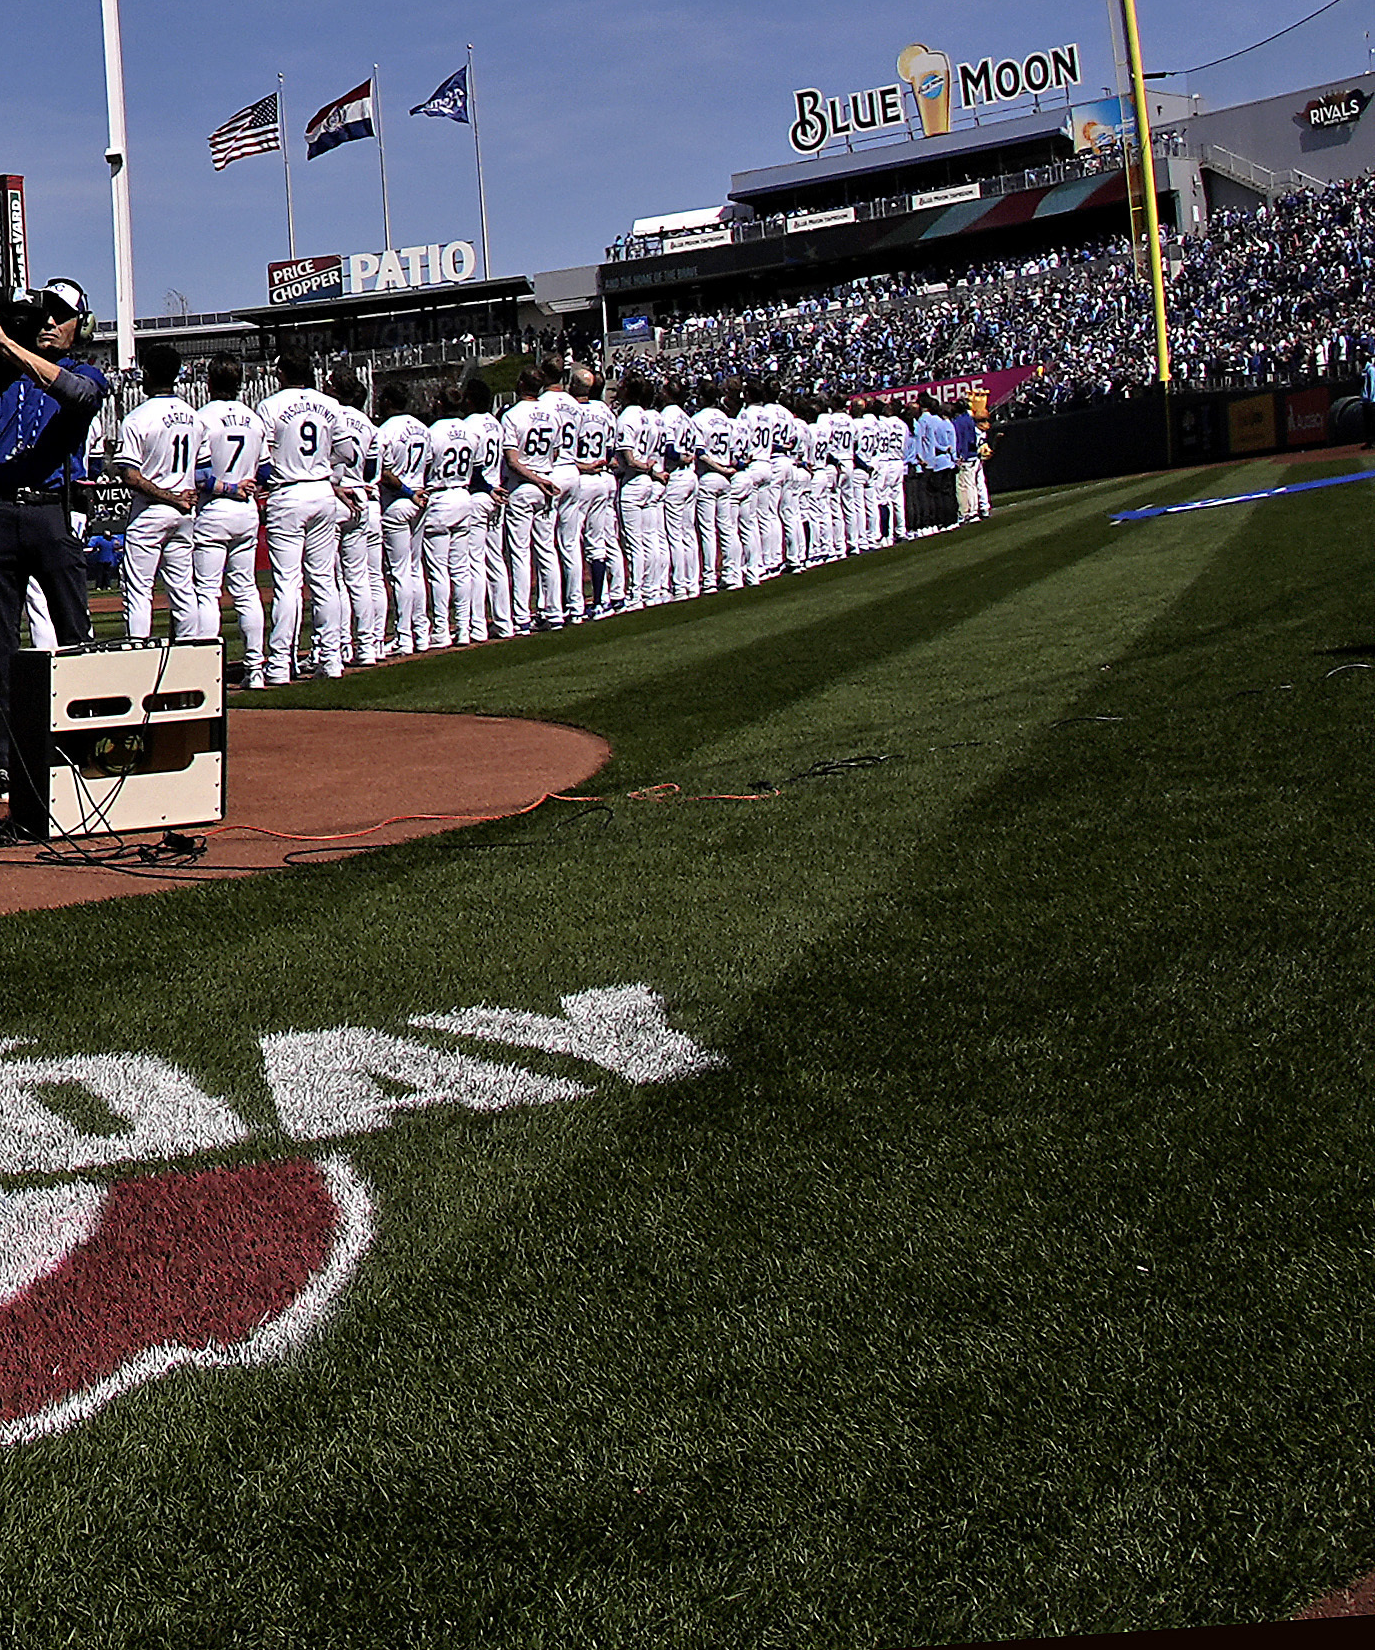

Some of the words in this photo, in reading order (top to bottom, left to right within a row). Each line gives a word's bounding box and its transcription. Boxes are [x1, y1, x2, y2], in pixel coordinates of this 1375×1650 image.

[788, 83, 904, 154] BLUE
[957, 43, 1082, 110] MOON
[1310, 99, 1360, 125] RIVALS
[272, 259, 316, 285] PRICE
[350, 240, 476, 294] PATIO
[272, 271, 341, 304] CHOPPER
[162, 413, 194, 428] GARCIA
[279, 402, 336, 424] PASQUANTINO
[300, 421, 318, 456] 9
[484, 438, 500, 467] 61
[525, 427, 553, 456] 65
[577, 431, 604, 459] 63
[752, 426, 771, 449] 30
[171, 433, 189, 473] 11
[225, 435, 245, 473] 7
[406, 442, 425, 473] 17
[443, 446, 471, 477] 28
